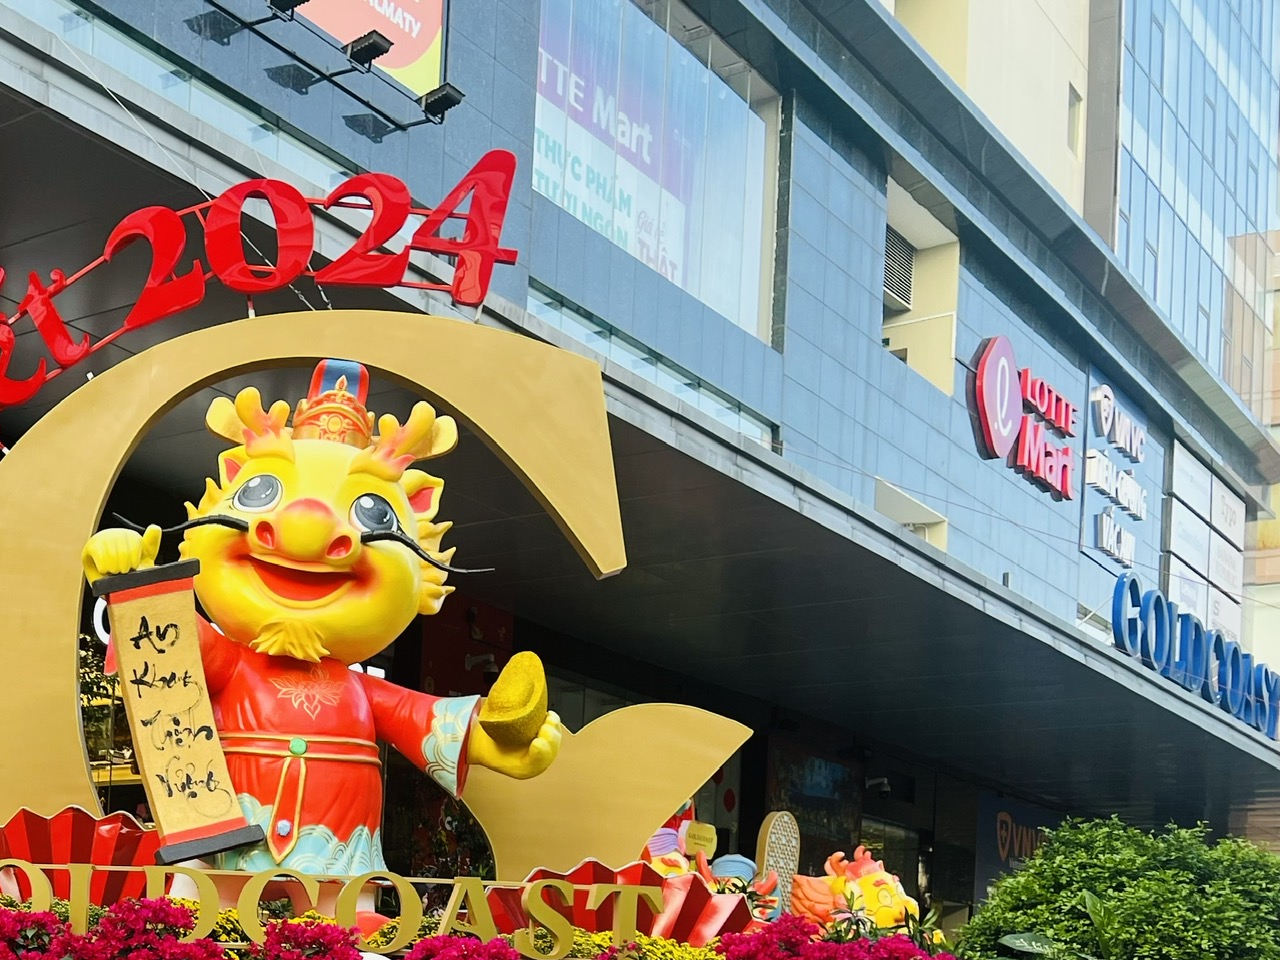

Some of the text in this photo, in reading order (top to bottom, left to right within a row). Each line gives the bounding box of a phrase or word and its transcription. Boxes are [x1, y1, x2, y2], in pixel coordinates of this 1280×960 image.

[363, 0, 421, 39] LMATY
[592, 86, 653, 165] Mart
[103, 150, 518, 331] 2024
[1021, 368, 1078, 437] LOTTE
[1017, 416, 1075, 500] Mart
[130, 616, 180, 654] An
